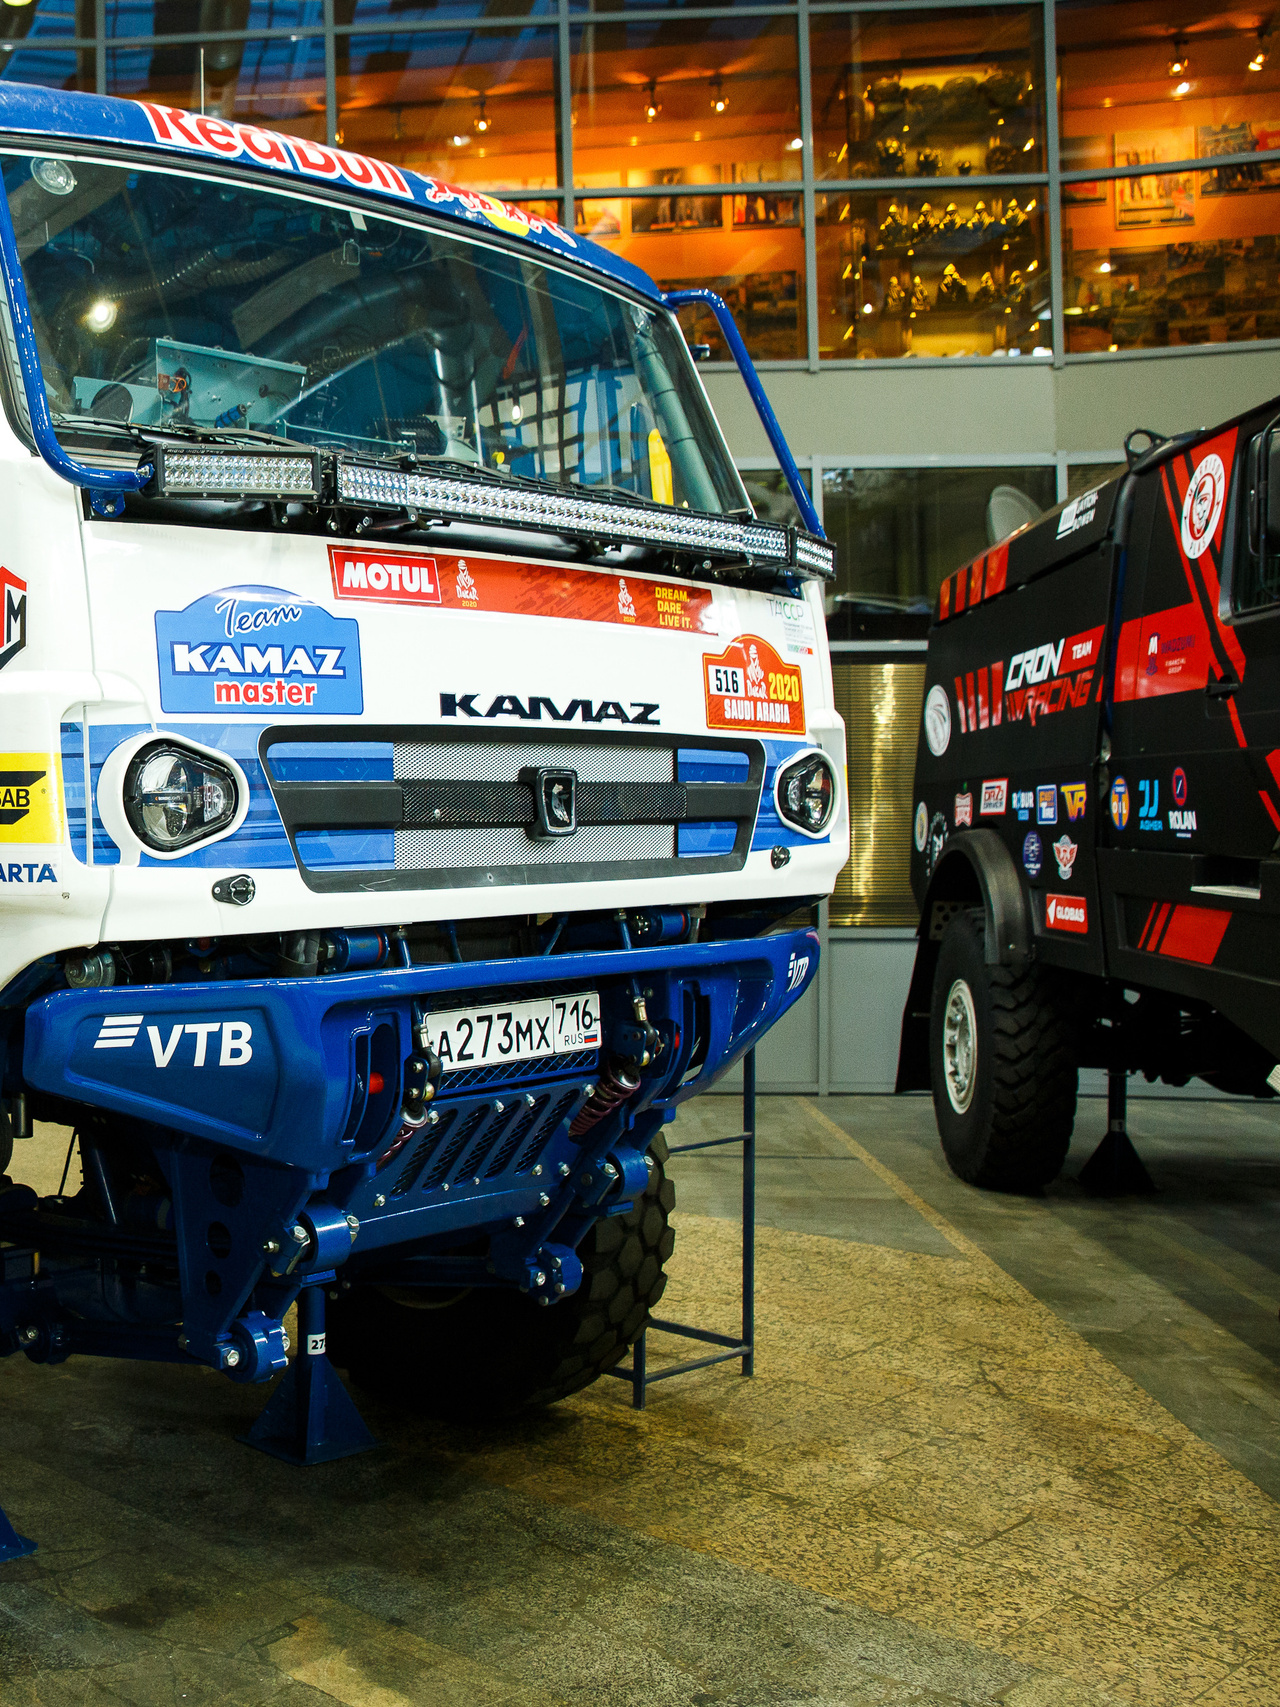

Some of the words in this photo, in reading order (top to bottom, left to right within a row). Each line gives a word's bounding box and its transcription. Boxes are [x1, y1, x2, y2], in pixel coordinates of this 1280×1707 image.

[140, 100, 292, 170] Red
[294, 134, 413, 199] Bull
[342, 561, 434, 594] MOTUL
[655, 586, 690, 602] DREAM.
[215, 598, 302, 637] Team
[657, 601, 684, 614] DARE.
[659, 614, 680, 627] LIVE
[681, 616, 693, 628] IT.
[172, 642, 346, 678] KAMAZ
[1004, 637, 1066, 692] CRON
[1072, 639, 1092, 660] TEAM
[215, 680, 317, 705] master
[715, 669, 739, 693] 516
[768, 672, 800, 702] 2020
[439, 692, 660, 726] KAMAZ
[724, 698, 754, 721] SAUDI
[756, 700, 790, 723] ARABIA
[787, 956, 810, 992] VTB
[555, 999, 593, 1035] 716
[147, 1021, 253, 1068] VTB
[564, 1032, 584, 1046] RUS
